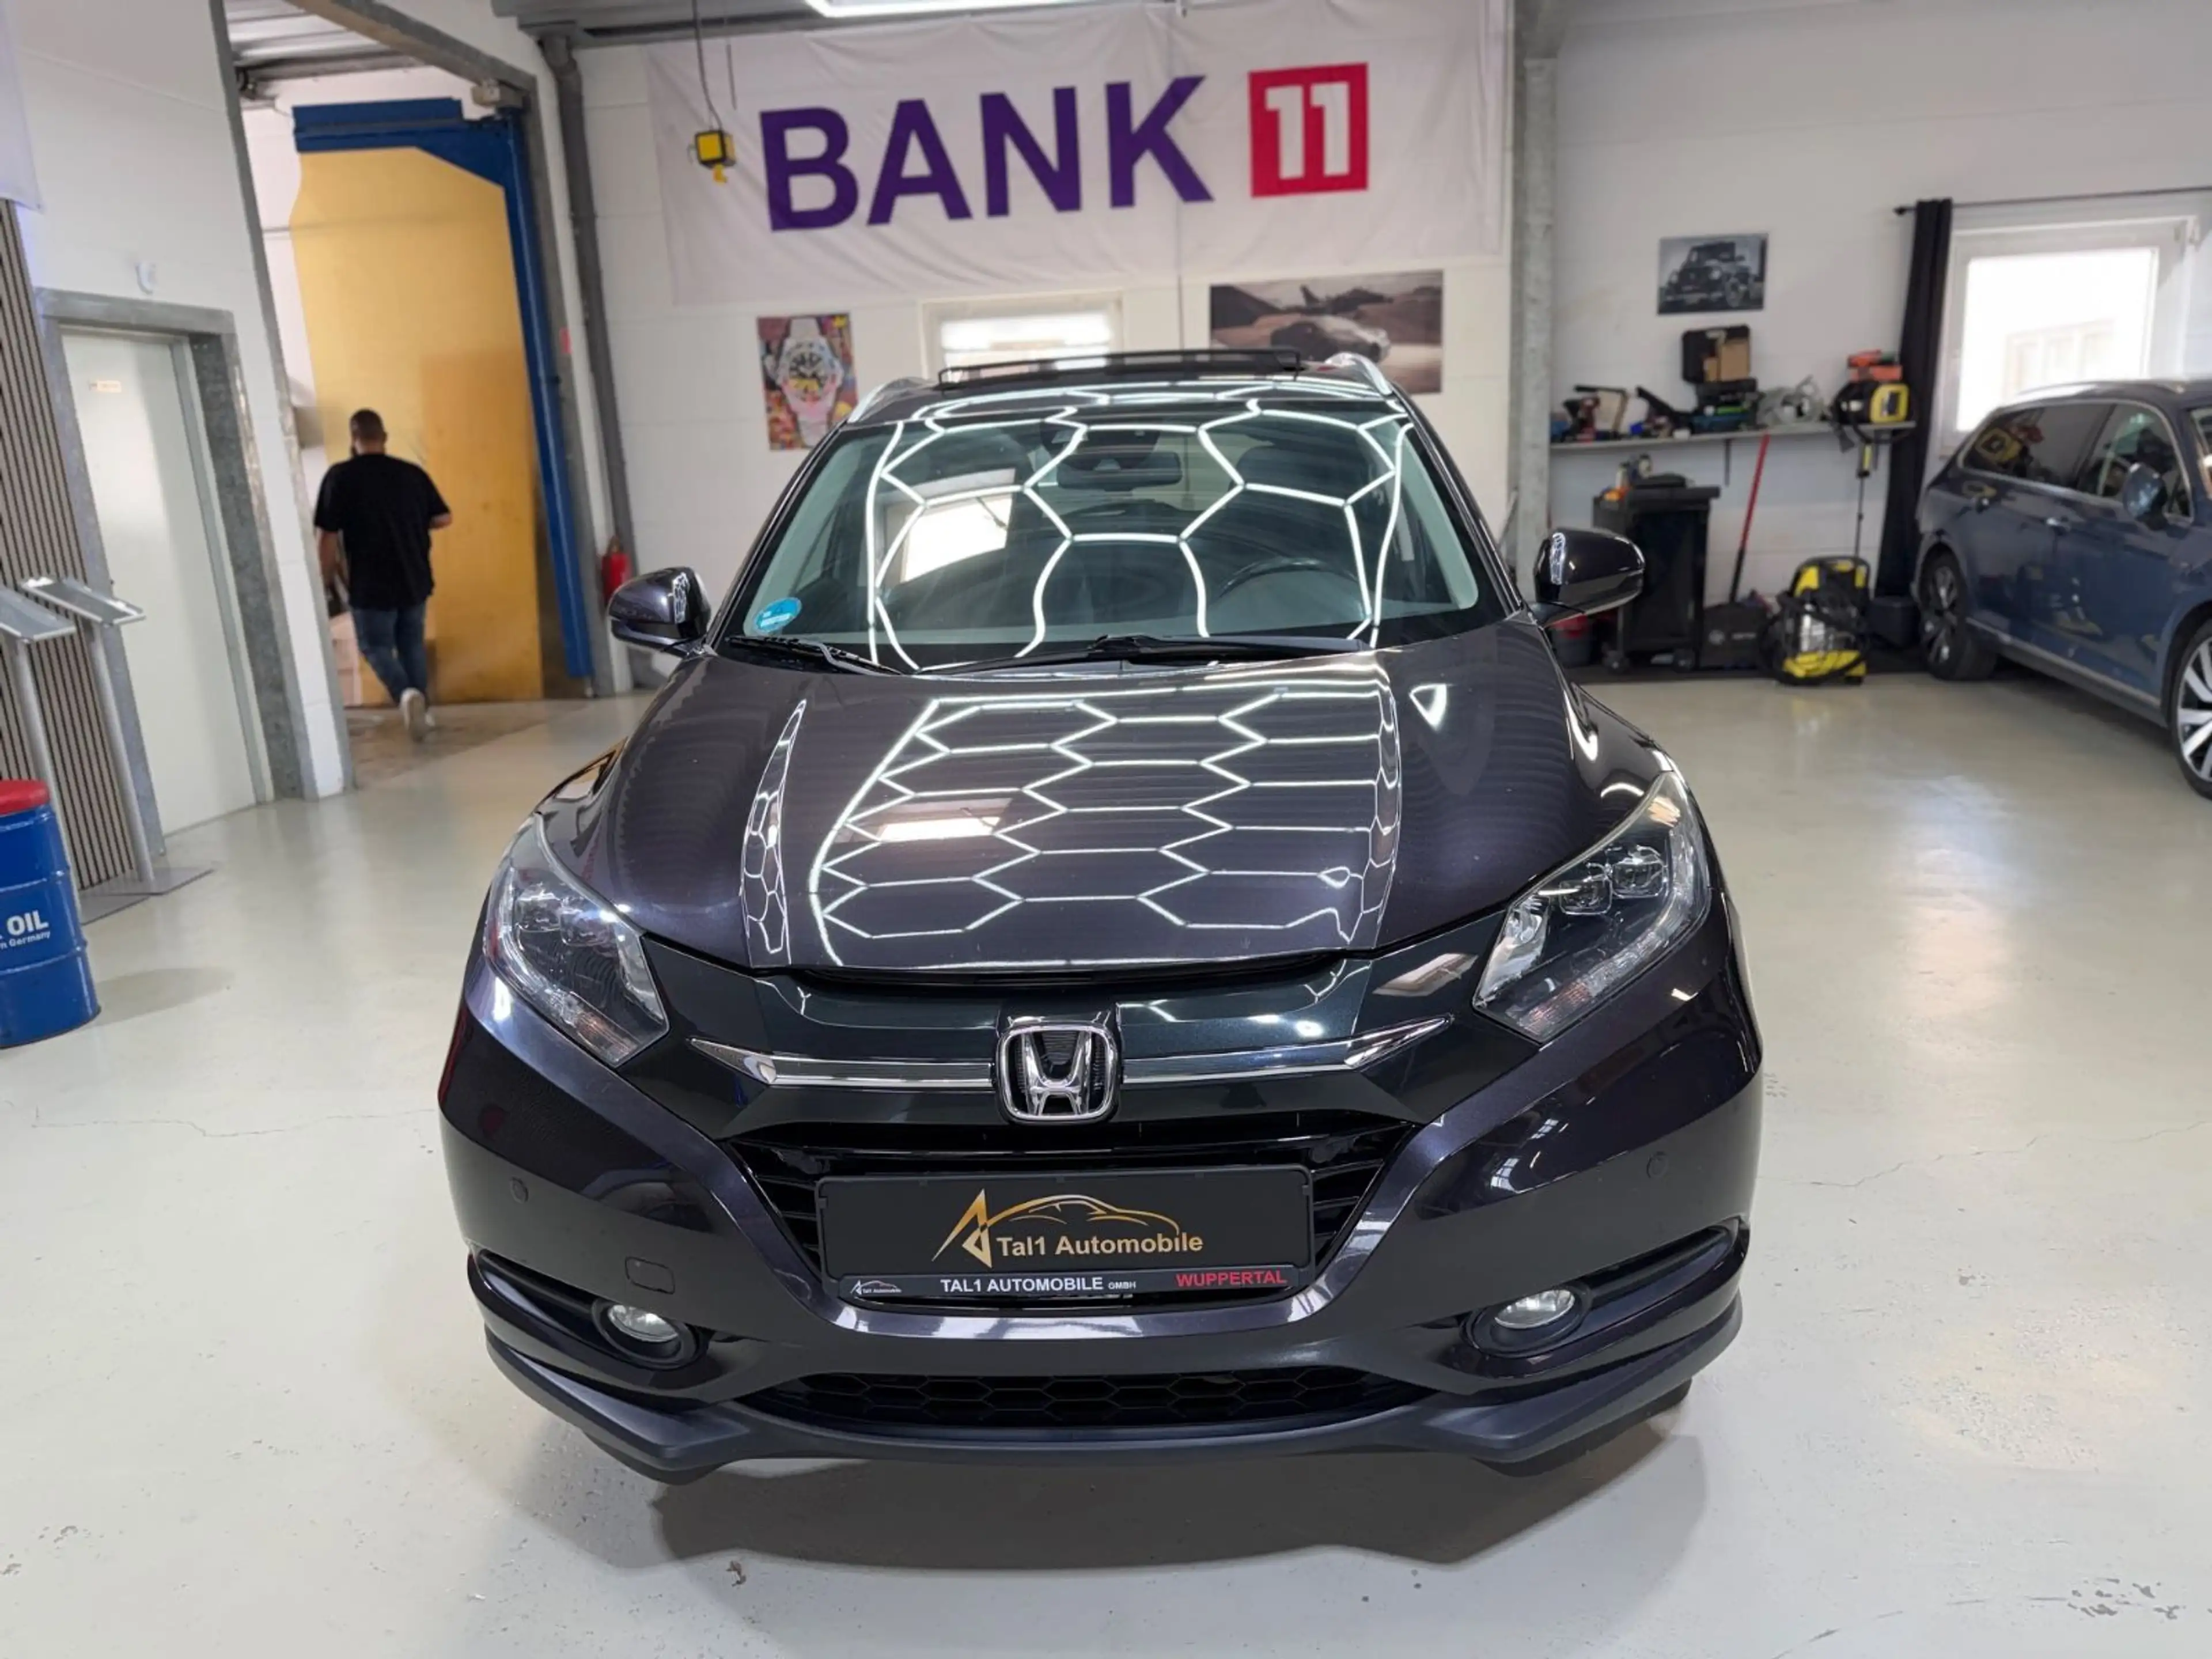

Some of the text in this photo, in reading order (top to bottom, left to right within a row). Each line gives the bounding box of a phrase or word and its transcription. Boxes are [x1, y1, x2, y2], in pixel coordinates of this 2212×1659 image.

[759, 75, 1350, 230] BANK 11
[7, 910, 48, 935] OIL
[9, 931, 50, 947] Germany
[997, 1232, 1203, 1256] Tal1 Automobile
[940, 1277, 1137, 1292] TAL1 AUTOMOBILE GMBH
[1176, 1270, 1287, 1287] WUPPERTAL
